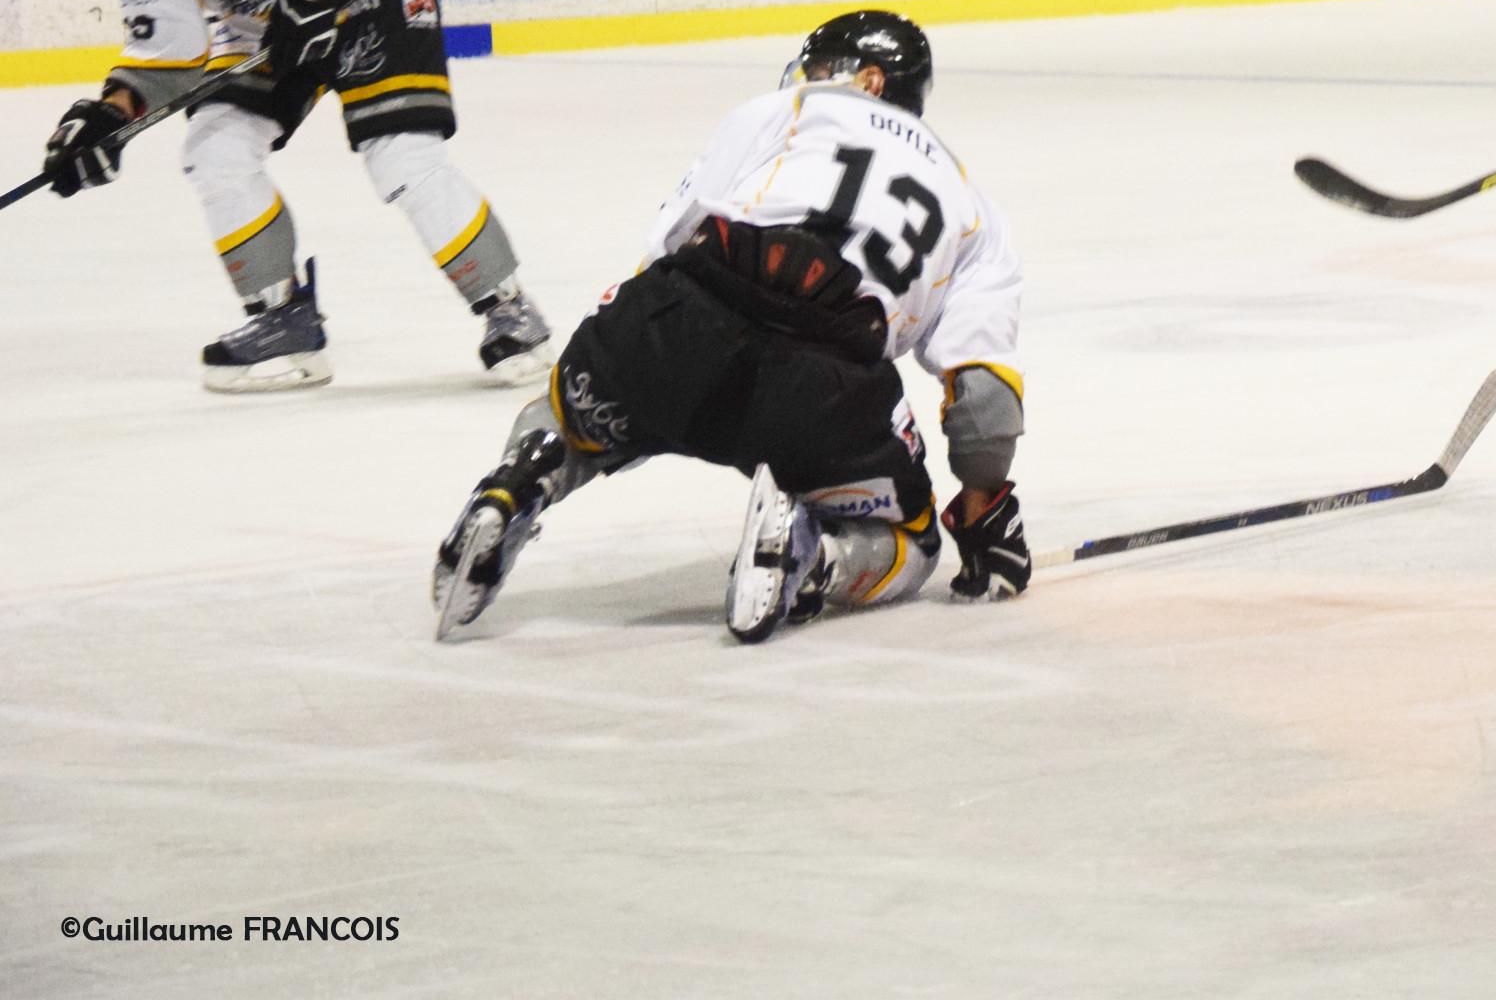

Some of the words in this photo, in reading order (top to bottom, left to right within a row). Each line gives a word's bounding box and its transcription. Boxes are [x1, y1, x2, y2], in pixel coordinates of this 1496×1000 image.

[869, 112, 938, 165] DOYLE
[802, 144, 945, 297] 13
[1305, 491, 1368, 516] NEXUS
